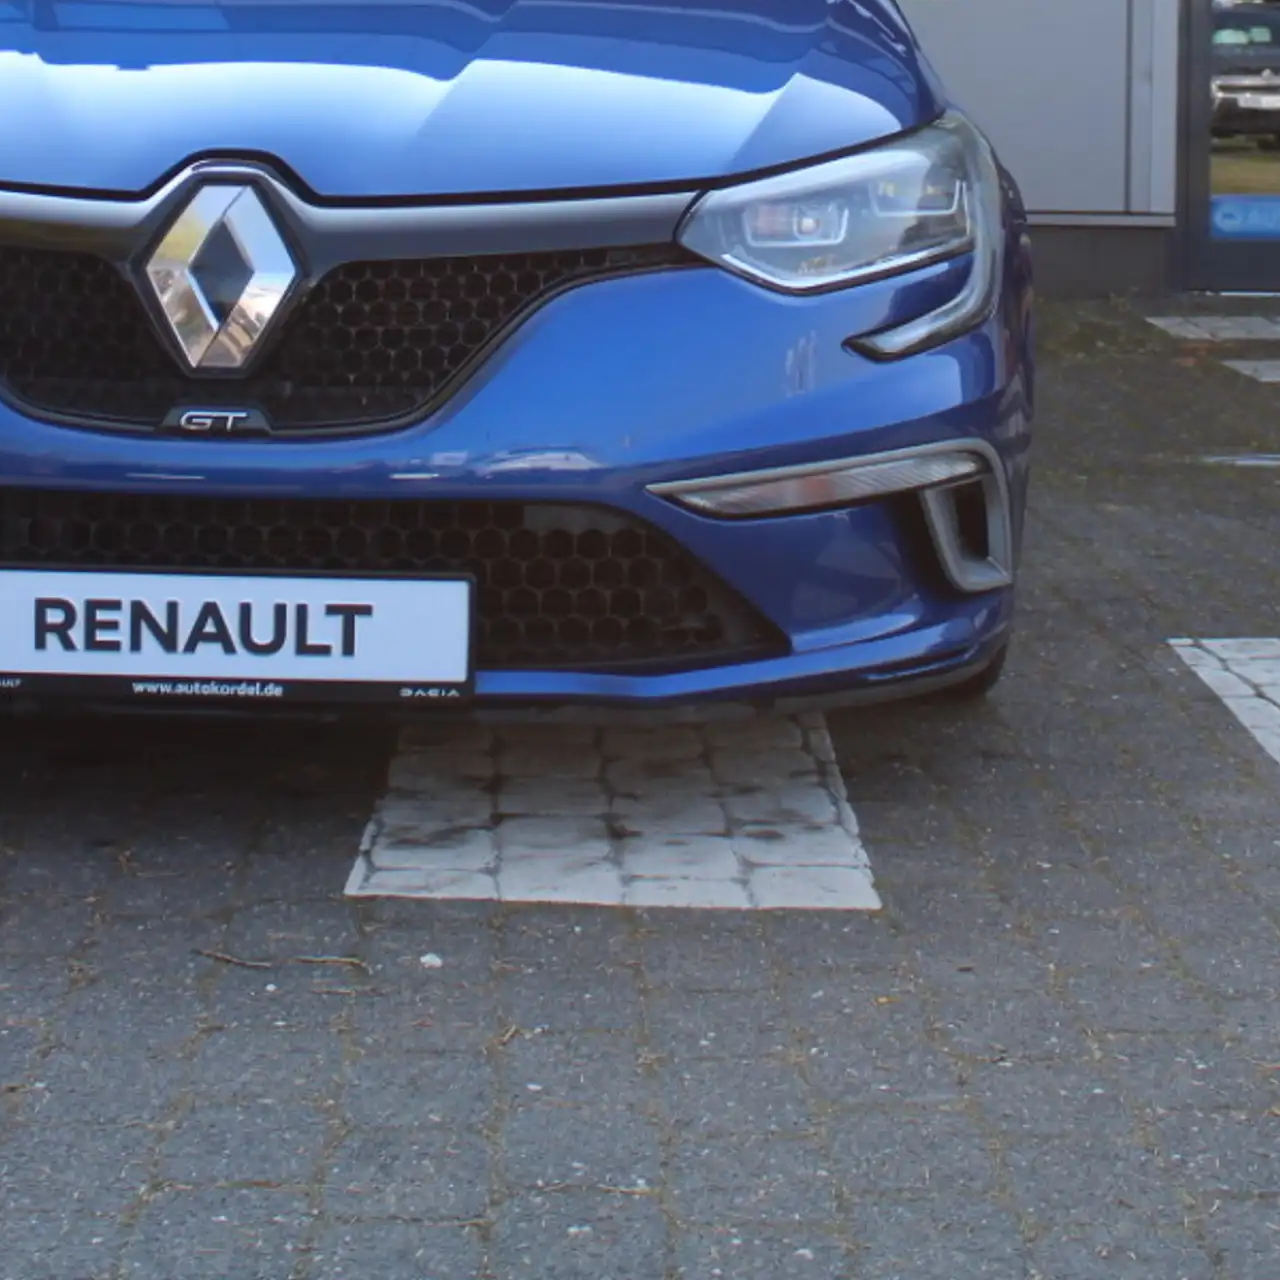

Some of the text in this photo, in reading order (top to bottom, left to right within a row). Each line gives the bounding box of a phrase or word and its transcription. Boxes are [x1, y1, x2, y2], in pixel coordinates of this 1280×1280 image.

[180, 411, 247, 432] GT
[34, 597, 373, 657] RENAULT
[132, 680, 284, 697] www.autokordel.de
